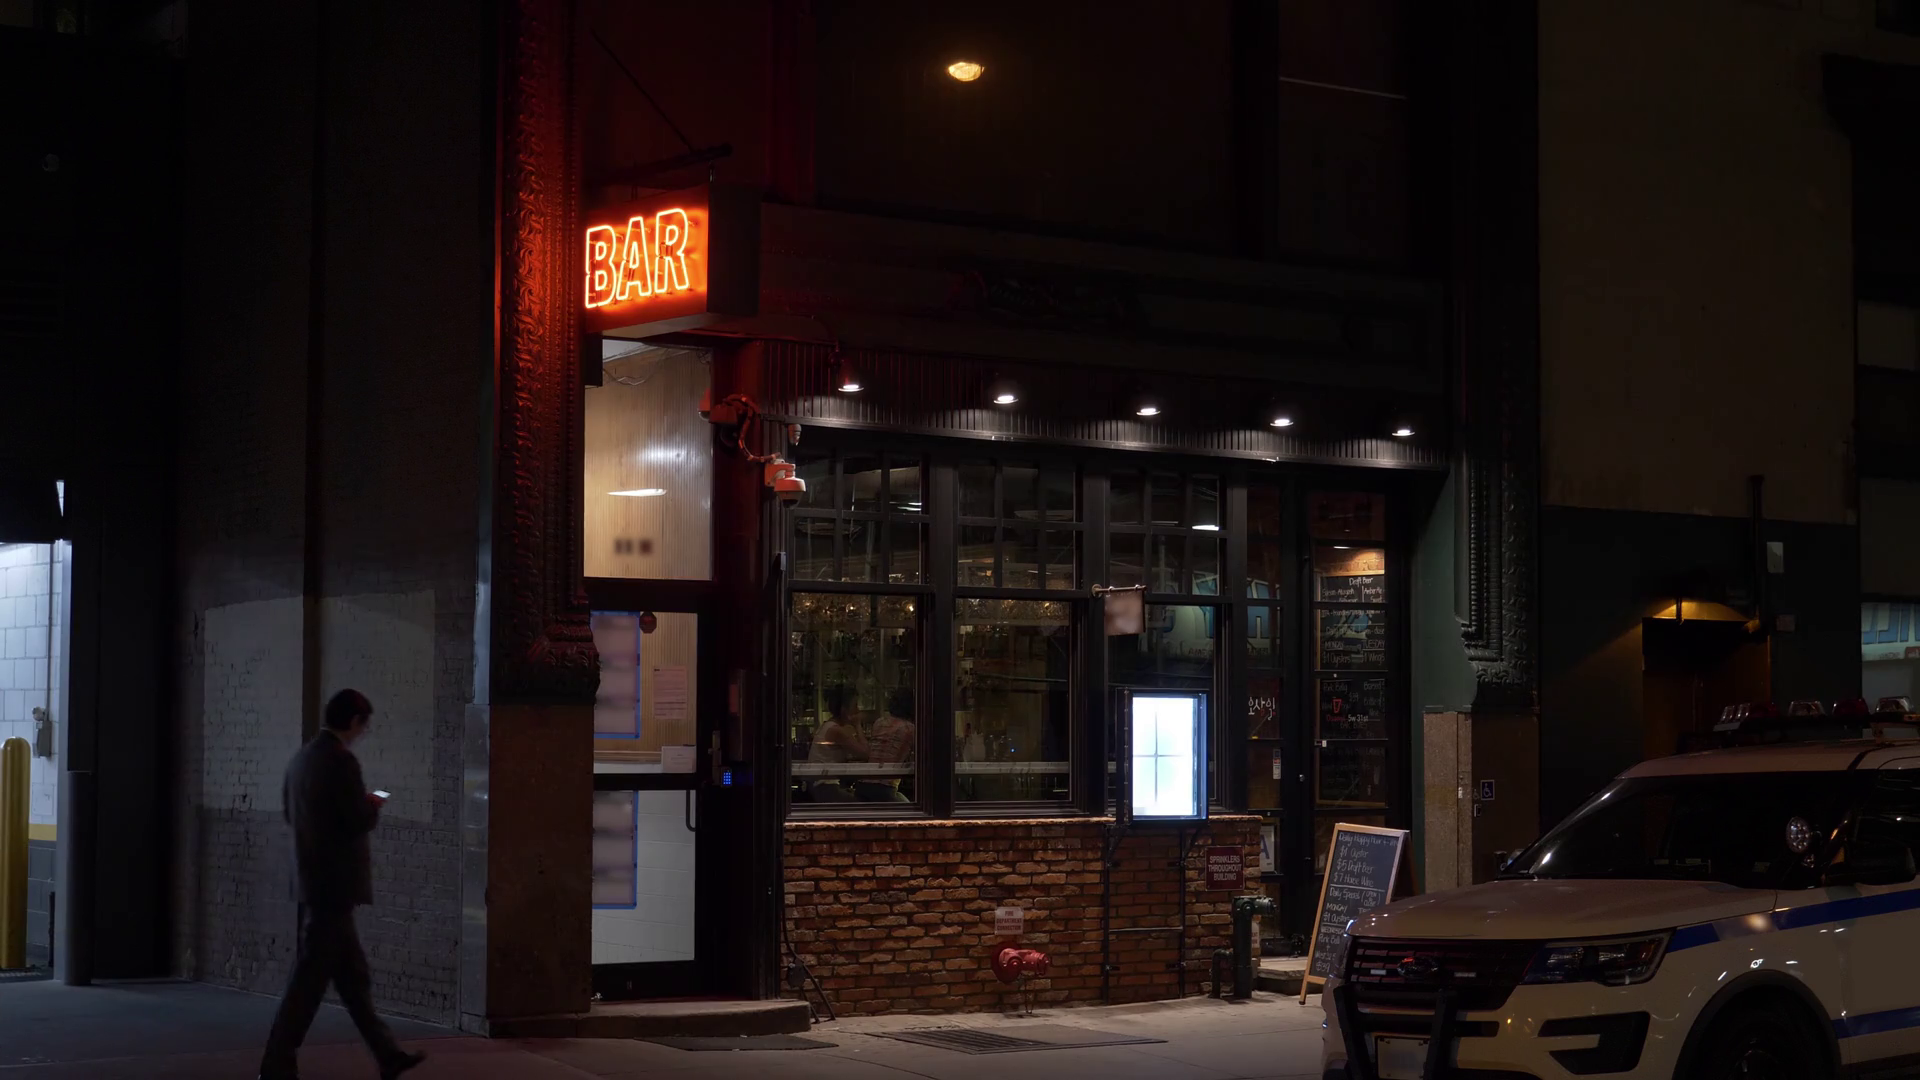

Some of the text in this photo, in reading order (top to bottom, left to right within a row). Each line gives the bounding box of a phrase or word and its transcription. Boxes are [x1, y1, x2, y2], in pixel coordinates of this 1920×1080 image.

[585, 207, 690, 309] BAR
[1209, 855, 1241, 864] SPRINKLERS
[1208, 864, 1242, 872] THROUGHOUT
[1337, 858, 1374, 875] $5 Draft Beer
[1214, 873, 1236, 881] BUILDING
[1334, 872, 1344, 882] $7
[1330, 887, 1342, 900] Daily
[1320, 926, 1345, 935] WEDNESDA
